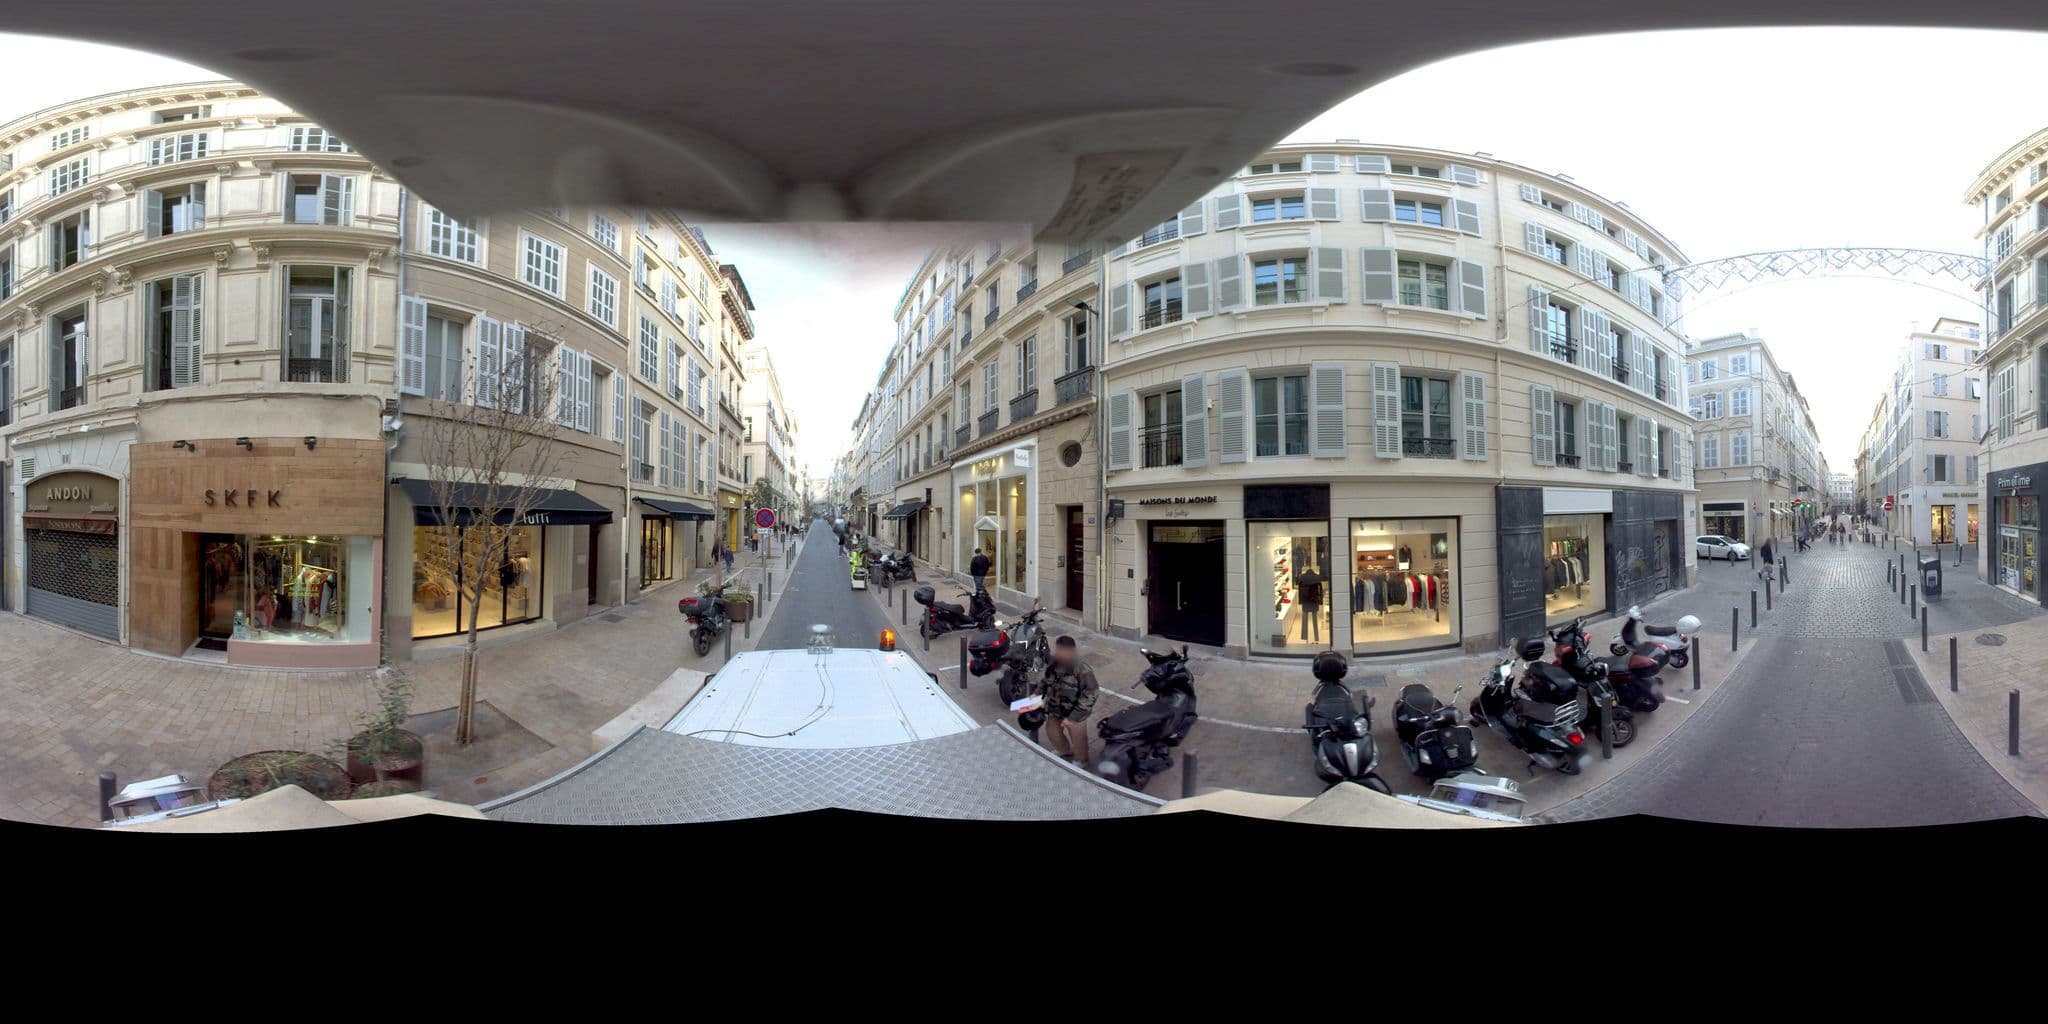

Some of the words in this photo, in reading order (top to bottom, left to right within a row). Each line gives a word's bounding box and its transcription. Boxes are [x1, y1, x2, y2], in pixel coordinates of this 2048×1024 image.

[47, 486, 91, 500] ANDON
[205, 489, 281, 507] SKFK
[1139, 497, 1172, 505] MAISONS
[1188, 496, 1218, 504] MONDE
